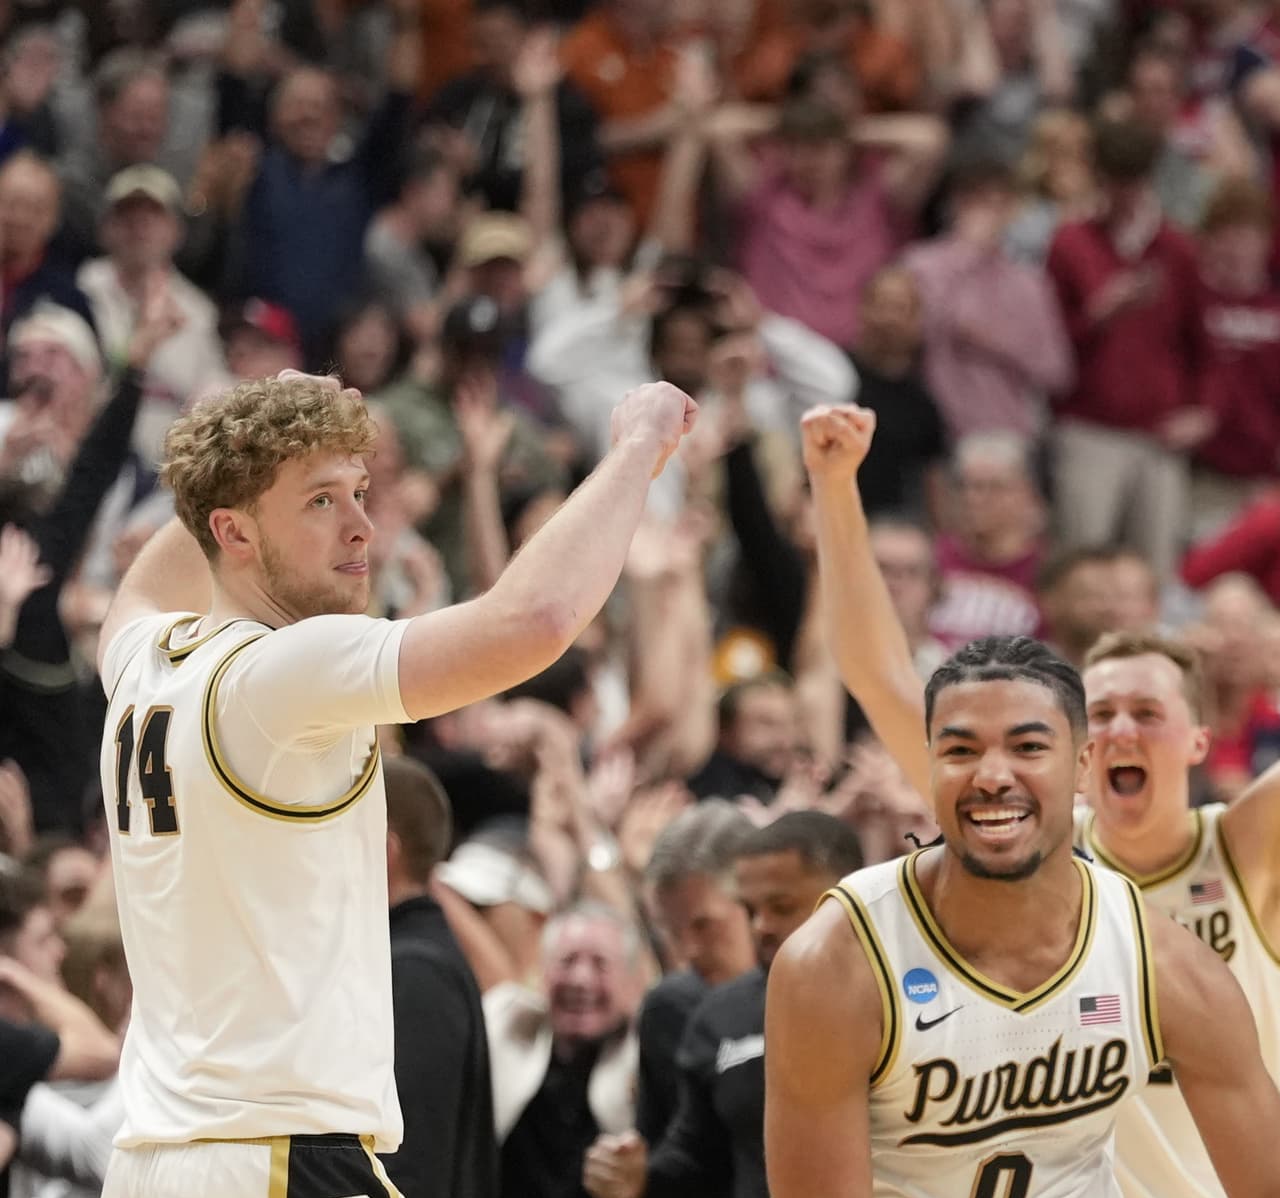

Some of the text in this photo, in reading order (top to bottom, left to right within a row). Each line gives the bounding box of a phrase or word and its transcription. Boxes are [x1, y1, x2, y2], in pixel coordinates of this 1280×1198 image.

[114, 704, 181, 837] 14
[908, 982, 937, 996] NCAA
[902, 1034, 1130, 1138] Purdue
